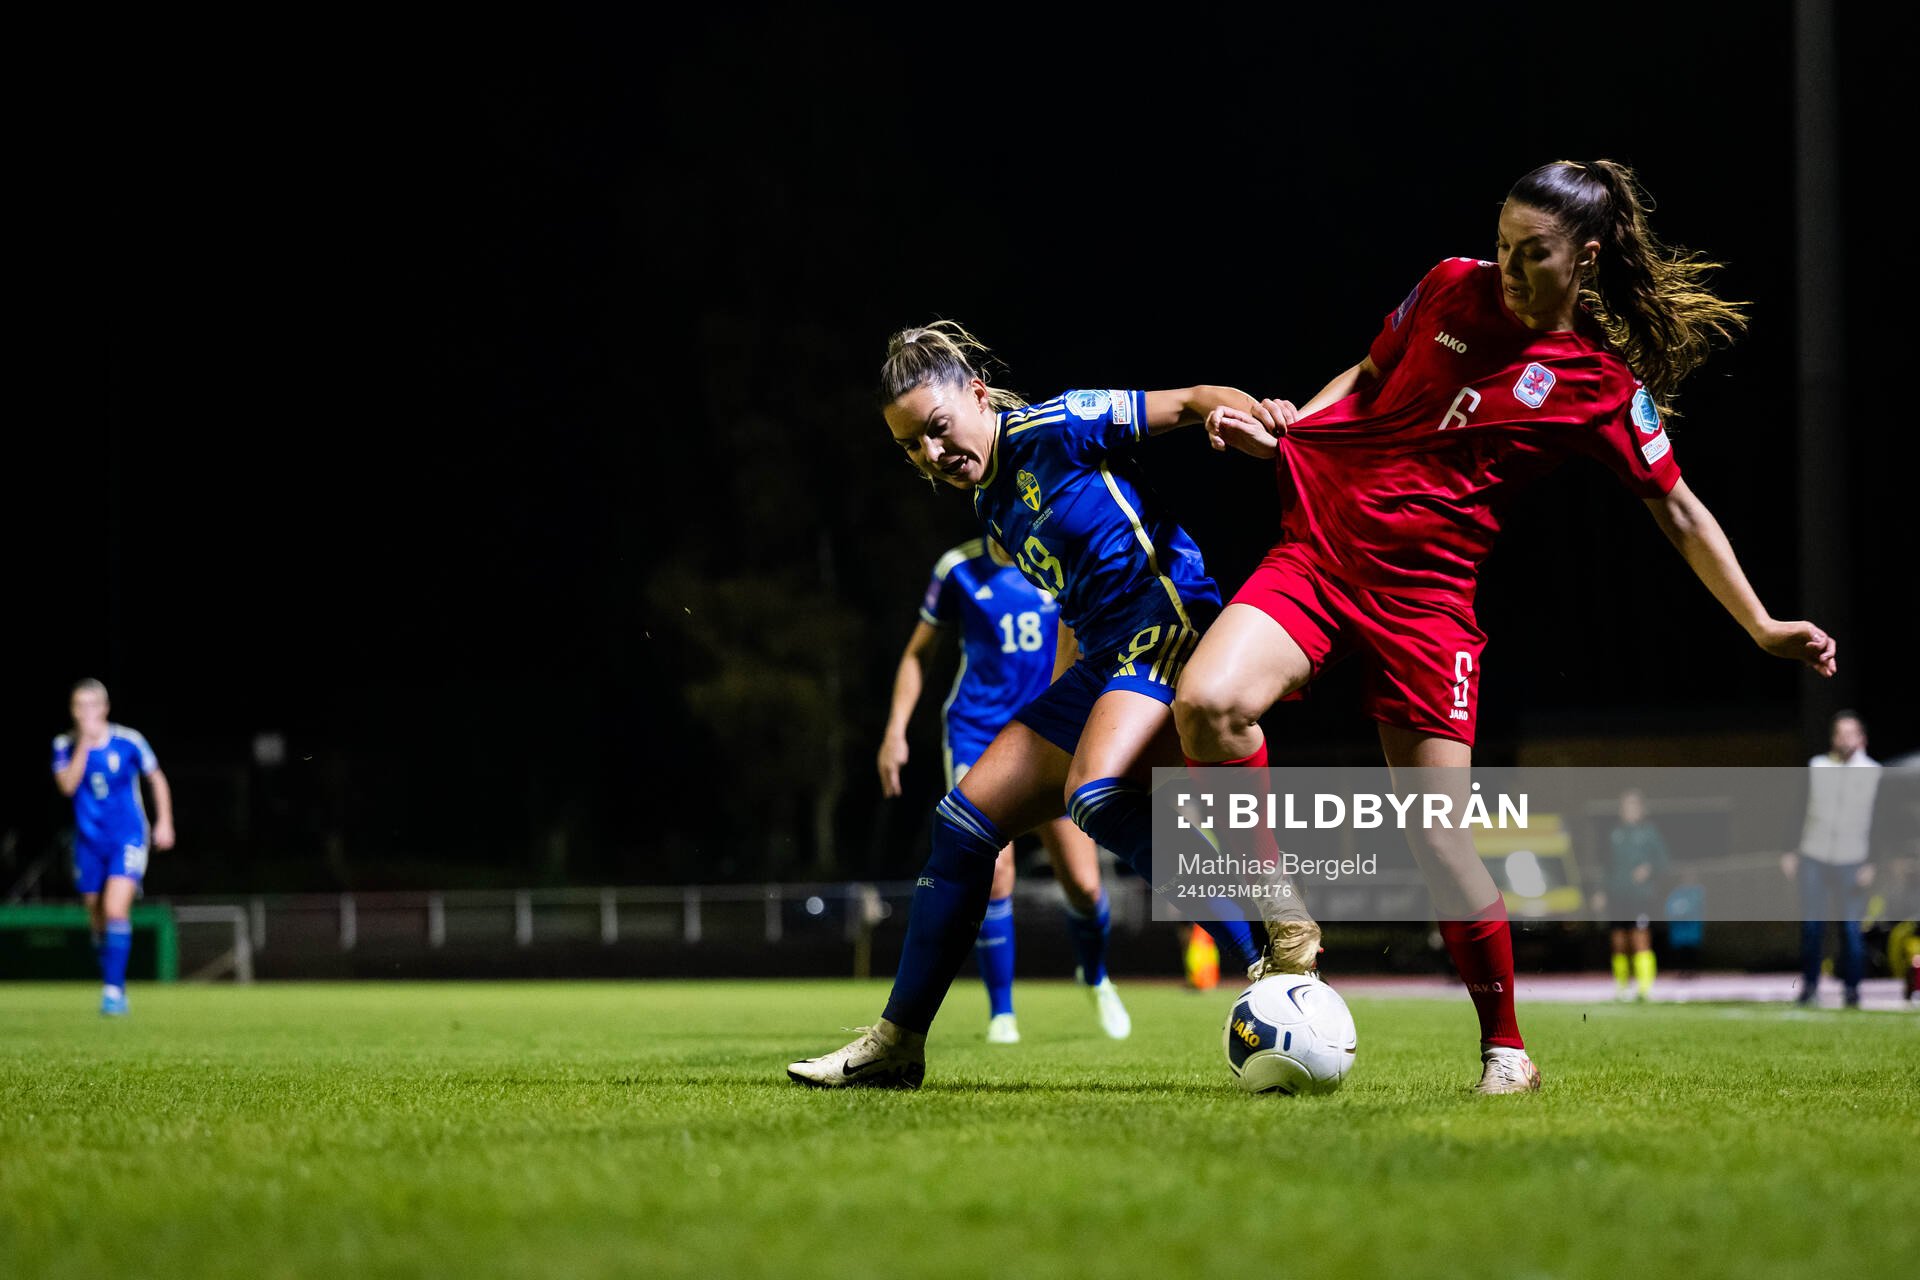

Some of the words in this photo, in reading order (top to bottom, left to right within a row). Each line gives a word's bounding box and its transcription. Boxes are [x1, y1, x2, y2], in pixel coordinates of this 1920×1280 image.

[1434, 330, 1467, 354] JAKO
[999, 611, 1043, 654] 18
[1449, 708, 1469, 721] JAKO
[1232, 1018, 1260, 1047] JAKO
